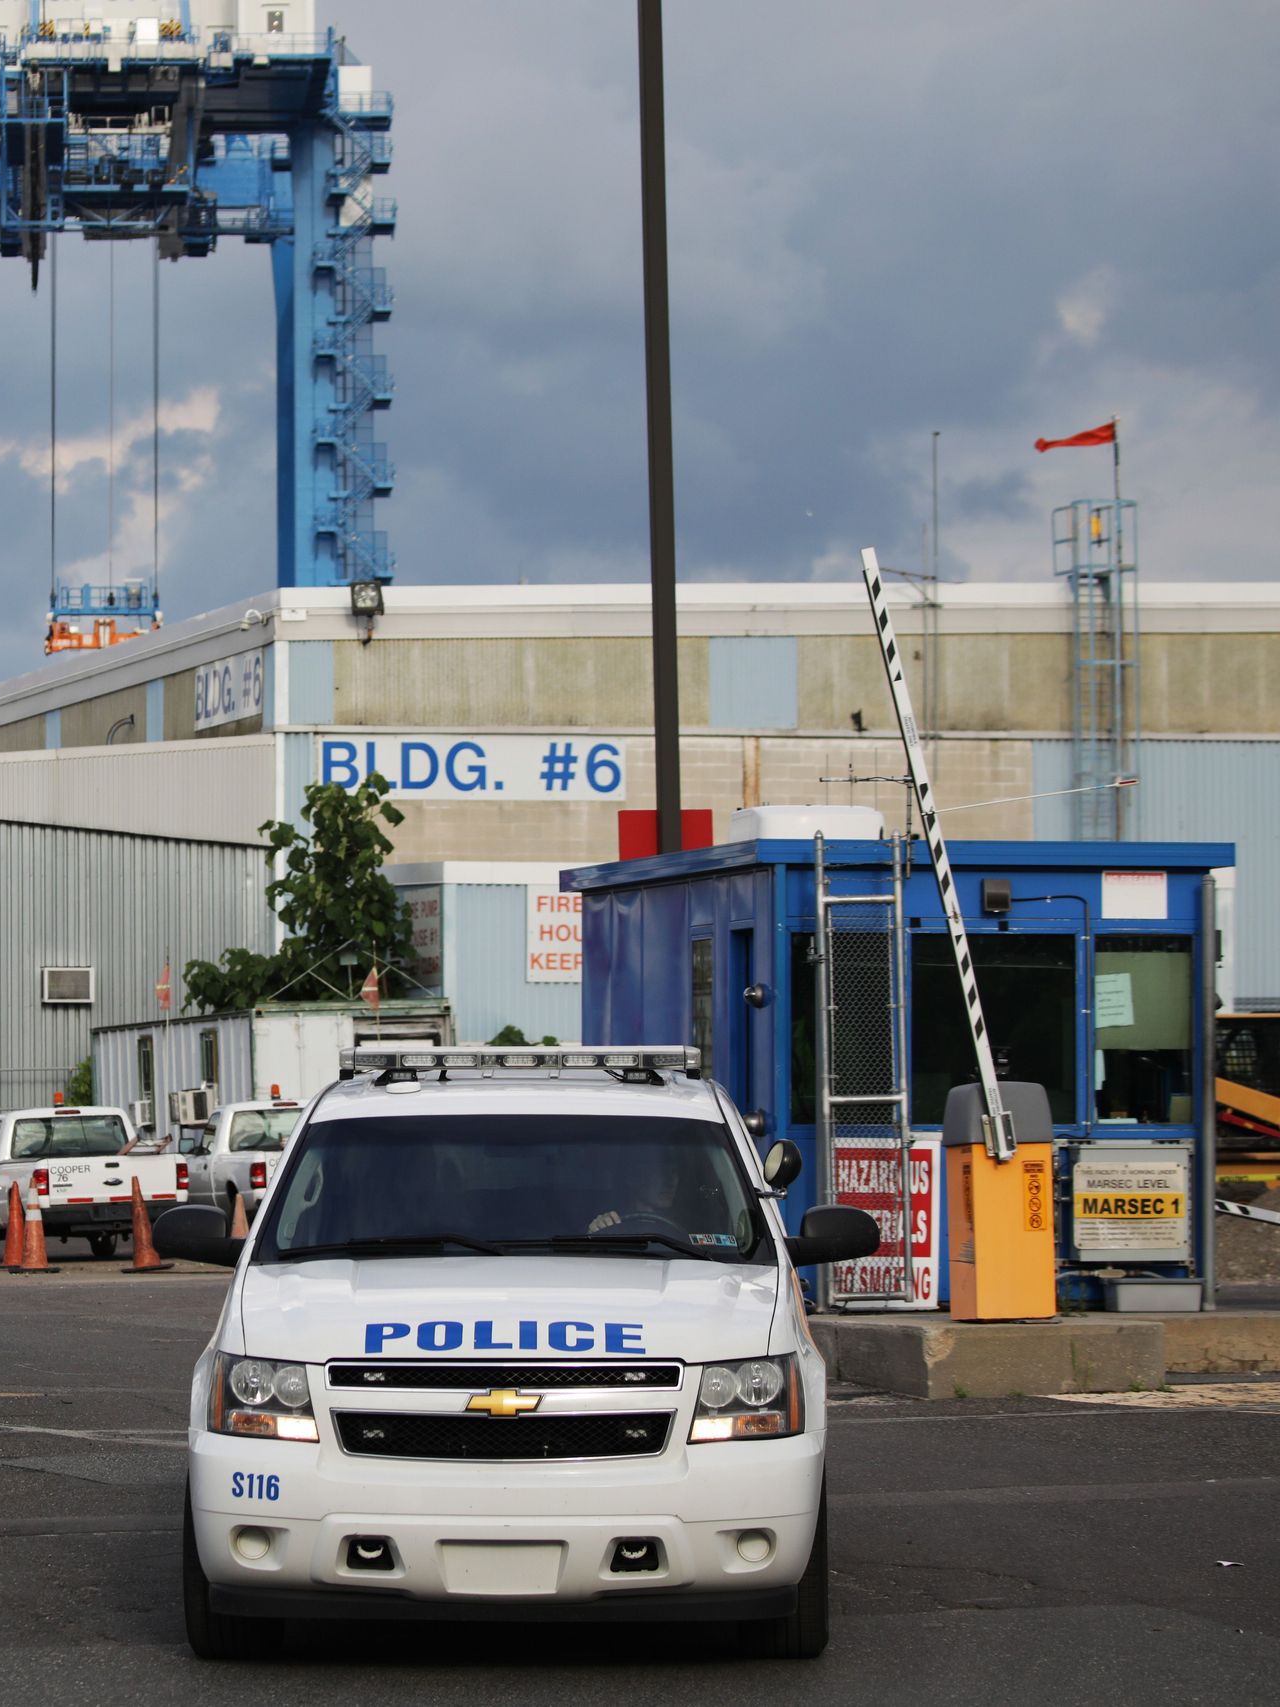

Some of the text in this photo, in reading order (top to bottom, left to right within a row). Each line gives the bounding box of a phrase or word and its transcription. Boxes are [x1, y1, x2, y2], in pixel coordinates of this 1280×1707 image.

[195, 656, 261, 721] BLDG. #6
[322, 741, 621, 793] BLDG. #6
[537, 895, 582, 912] FIRE
[50, 1164, 90, 1175] COOPER
[57, 1174, 68, 1182] 76
[1087, 1179, 1170, 1189] MARSEC LEVEL
[1082, 1198, 1179, 1215] MARSEC 1
[860, 1266, 931, 1299] SMOKNG
[365, 1320, 646, 1354] POLICE
[232, 1471, 280, 1501] S116
